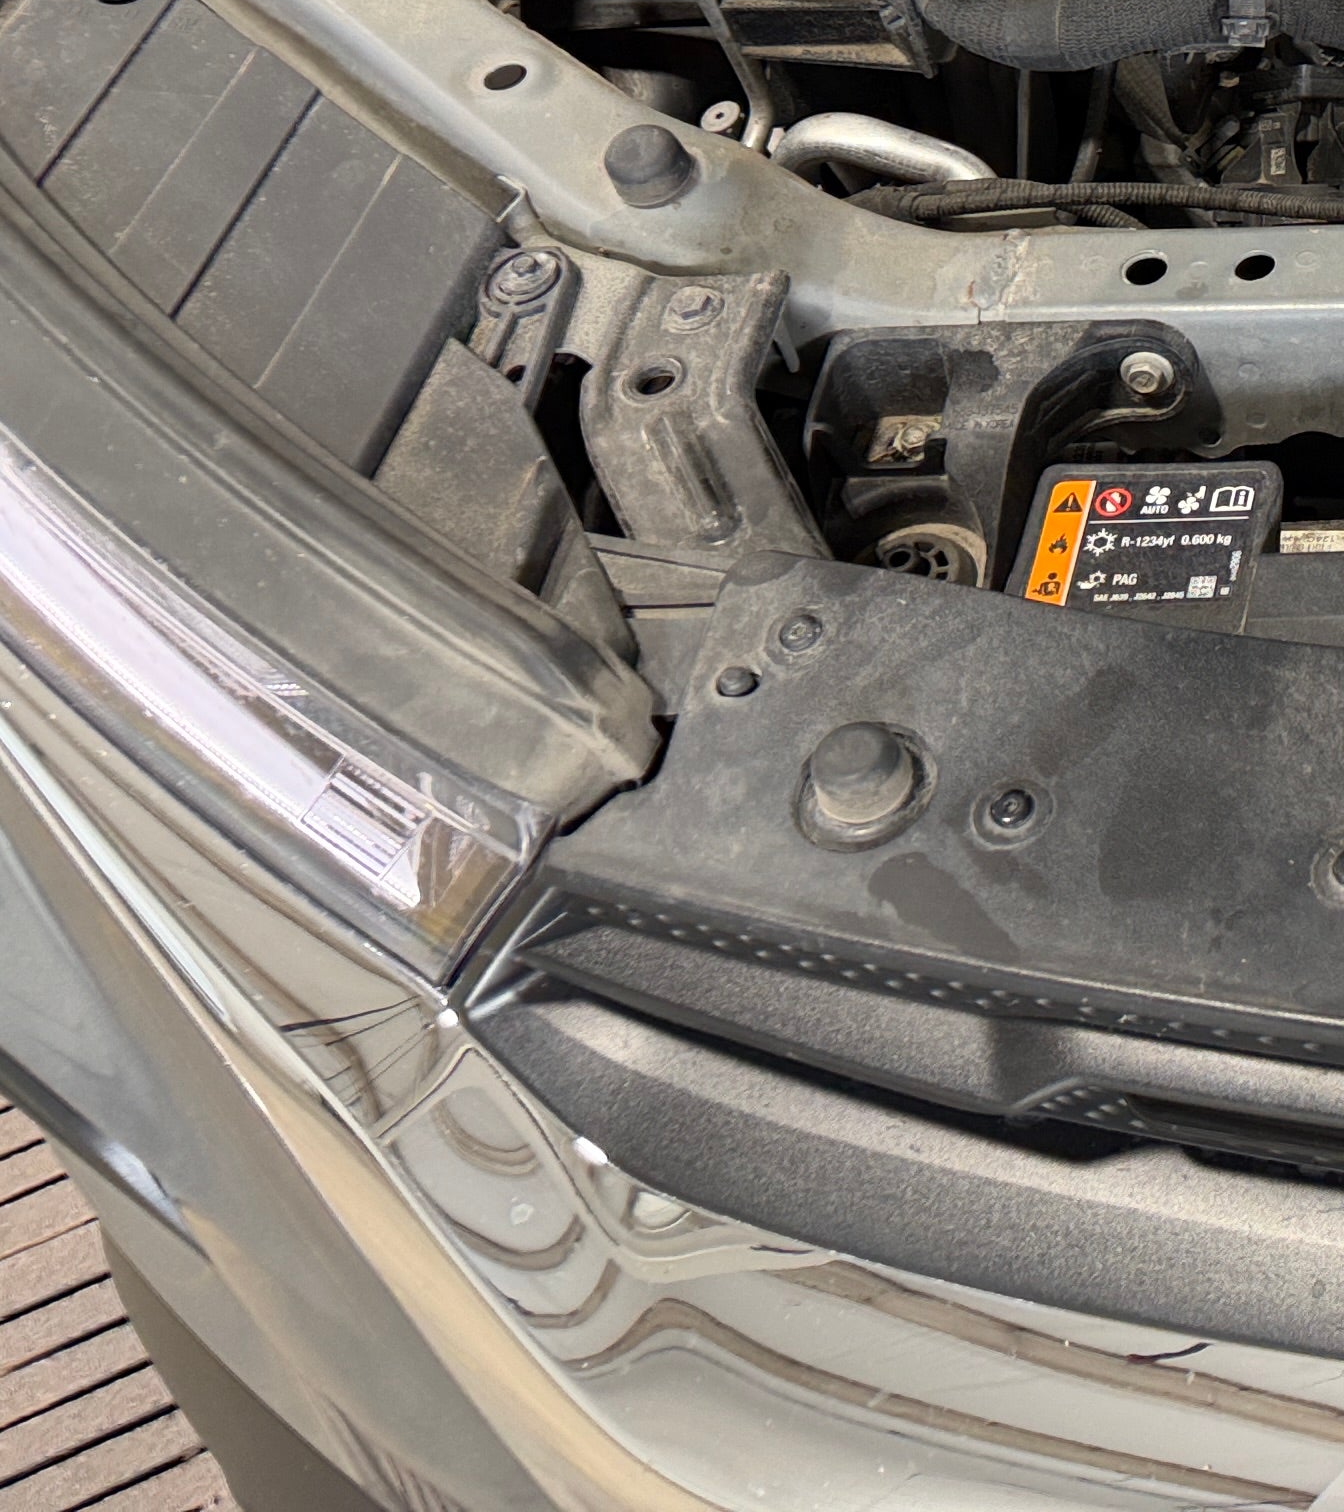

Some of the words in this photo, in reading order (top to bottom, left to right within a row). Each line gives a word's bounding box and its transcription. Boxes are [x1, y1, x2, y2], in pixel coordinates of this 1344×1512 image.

[1140, 504, 1169, 515] AUTO
[1121, 535, 1175, 548] R-1234yf
[1181, 534, 1214, 546] 0.600
[1216, 533, 1232, 546] kg
[1112, 573, 1138, 586] PAG
